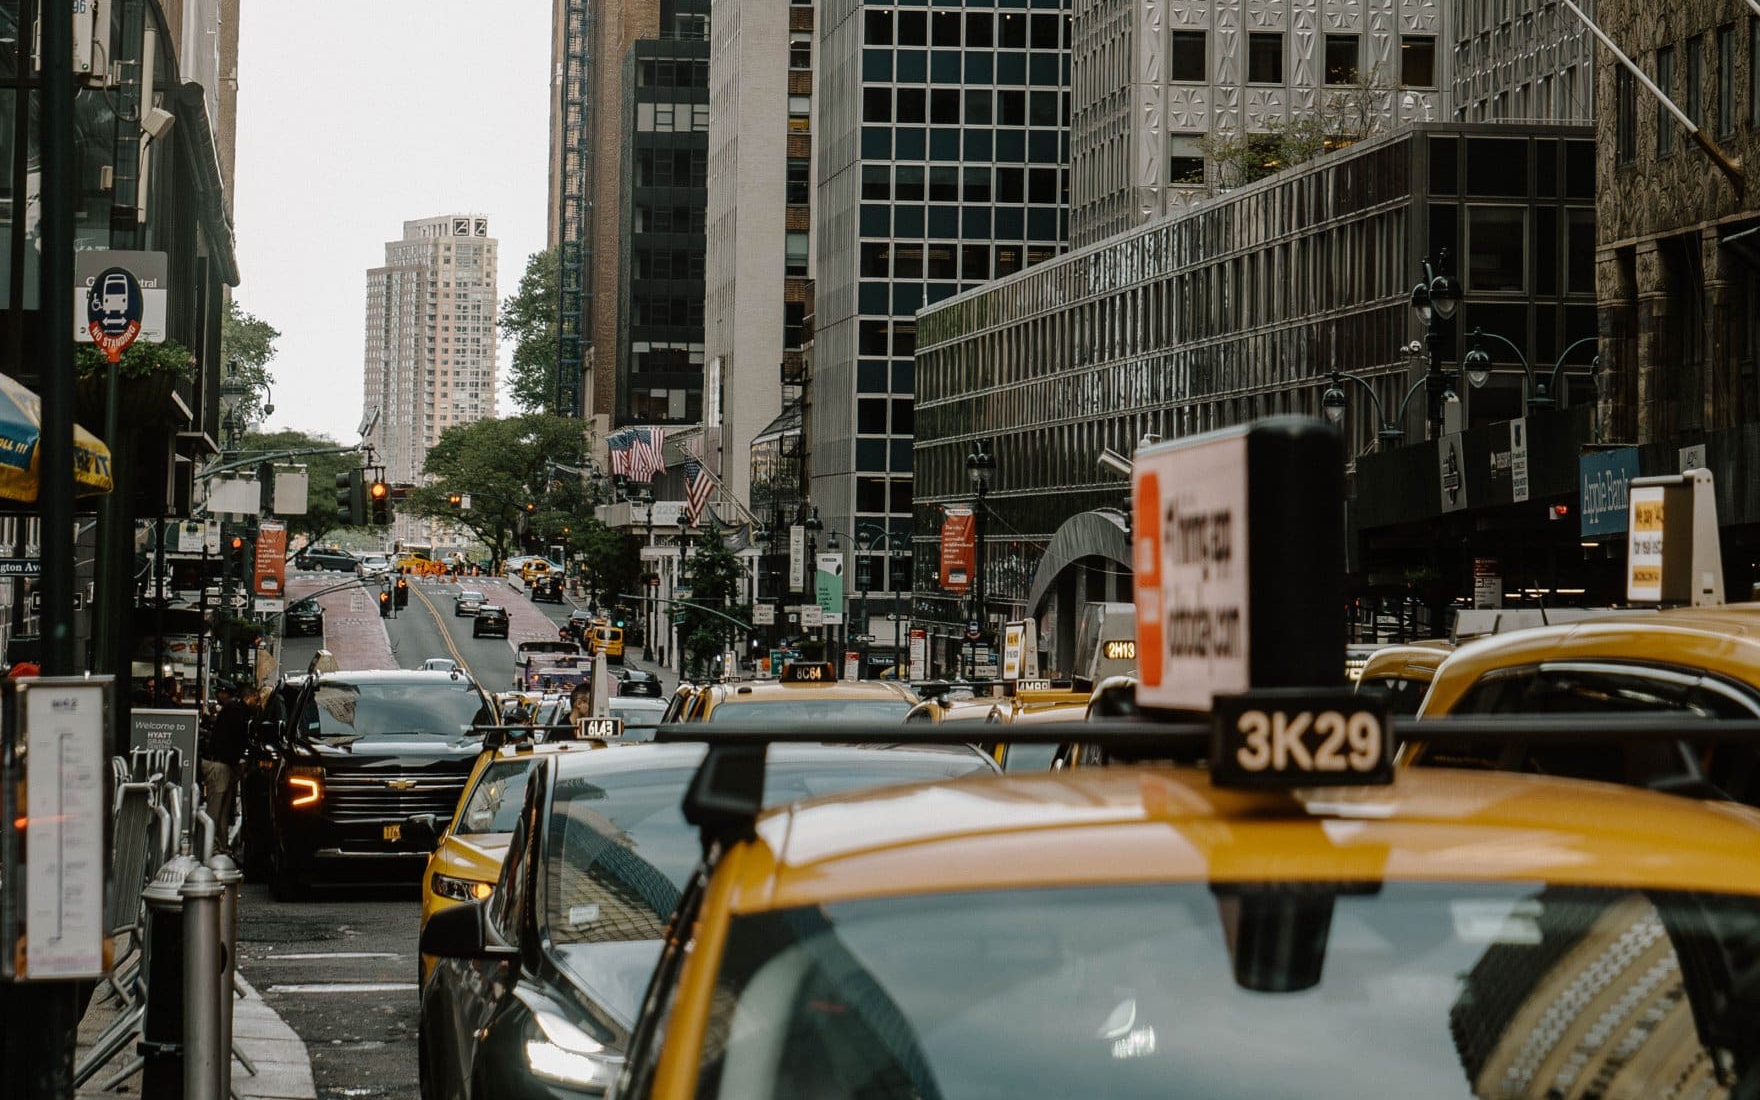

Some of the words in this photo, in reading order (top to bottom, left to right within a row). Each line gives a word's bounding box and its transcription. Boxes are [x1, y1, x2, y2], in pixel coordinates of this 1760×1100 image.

[139, 278, 158, 288] tral
[92, 325, 103, 342] NO
[102, 325, 137, 350] STANDING
[1583, 471, 1607, 525] Apple
[1108, 642, 1135, 659] 2H13
[796, 666, 822, 680] 8C64
[135, 721, 175, 731] Welcome
[176, 723, 186, 731] to
[588, 720, 613, 737] 6L43
[147, 731, 173, 739] HYATT
[1237, 710, 1382, 772] 3K29
